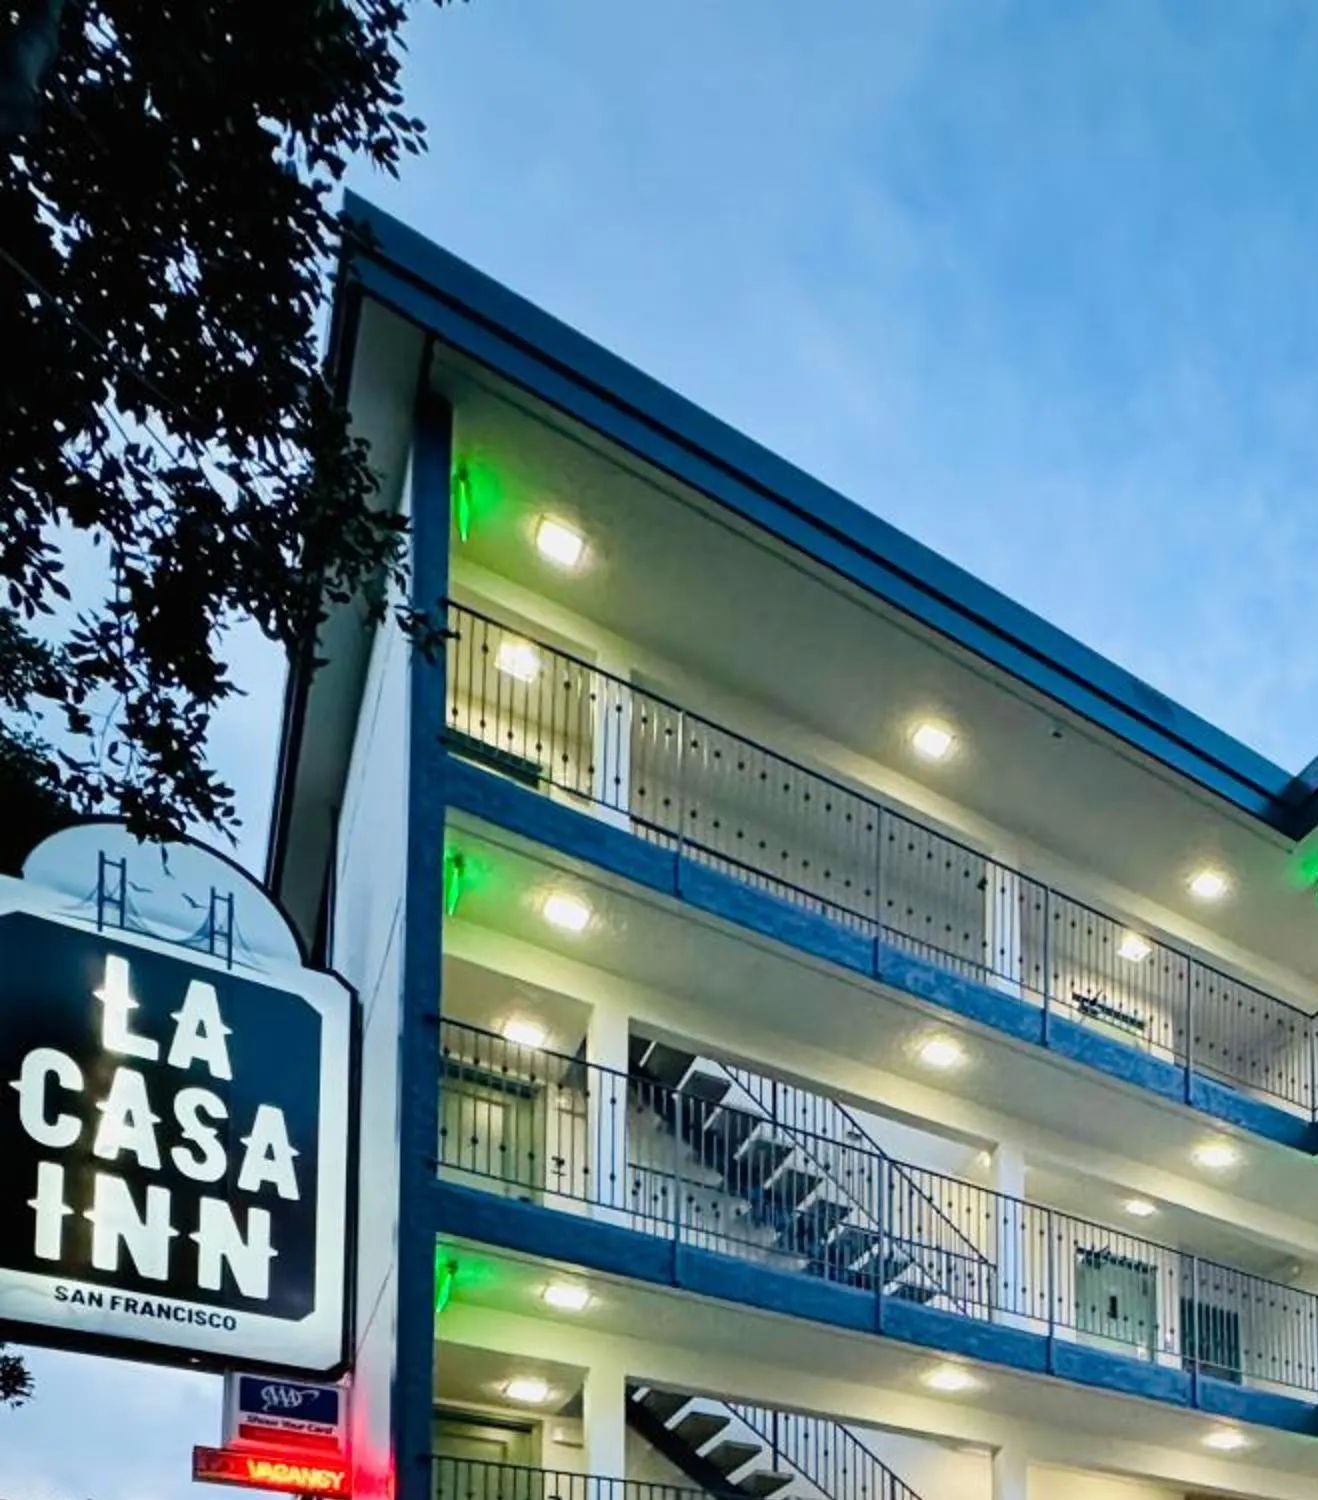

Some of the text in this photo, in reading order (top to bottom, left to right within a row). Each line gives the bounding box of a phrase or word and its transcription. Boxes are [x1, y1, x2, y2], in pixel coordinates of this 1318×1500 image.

[93, 953, 233, 1081] LA
[9, 1046, 301, 1200] CASA
[27, 1161, 279, 1300] INN
[53, 1285, 238, 1332] SAN FRANCISCO
[246, 1456, 345, 1490] VACANCY
